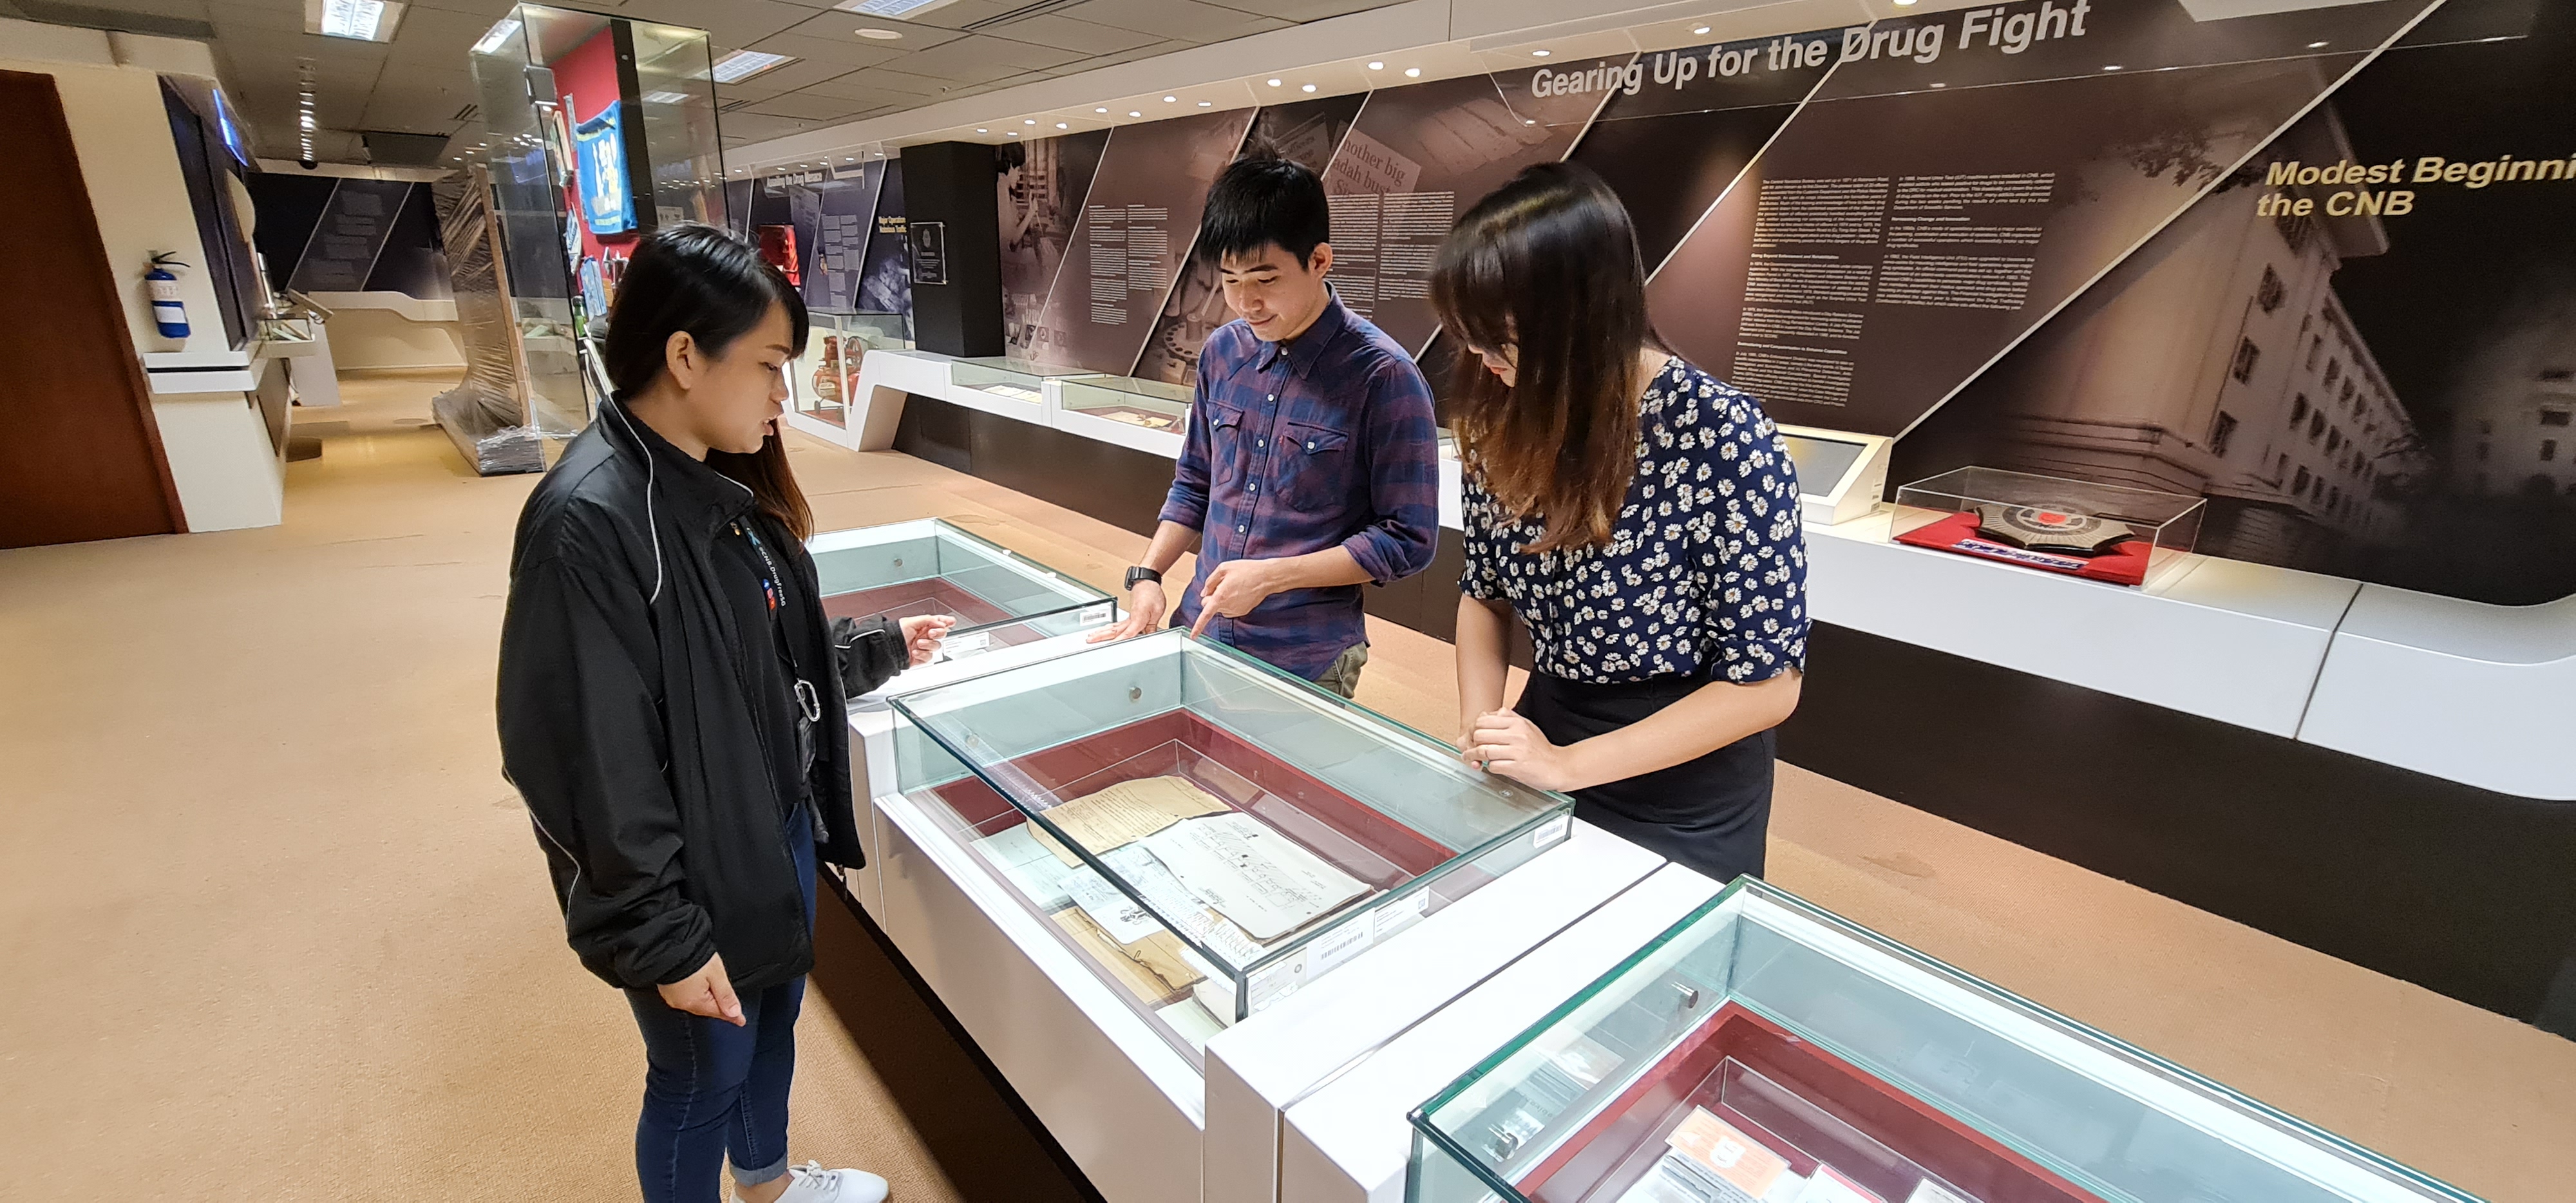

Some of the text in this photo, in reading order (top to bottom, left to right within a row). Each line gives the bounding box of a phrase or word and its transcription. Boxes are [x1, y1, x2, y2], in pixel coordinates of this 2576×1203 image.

[1531, 0, 2091, 96] Gearing Up for the Drug Fight
[1338, 134, 1384, 169] nother
[1385, 157, 1405, 187] big
[2266, 158, 2405, 185] Modest
[1363, 171, 1391, 194] bust
[2257, 191, 2416, 216] the CNB
